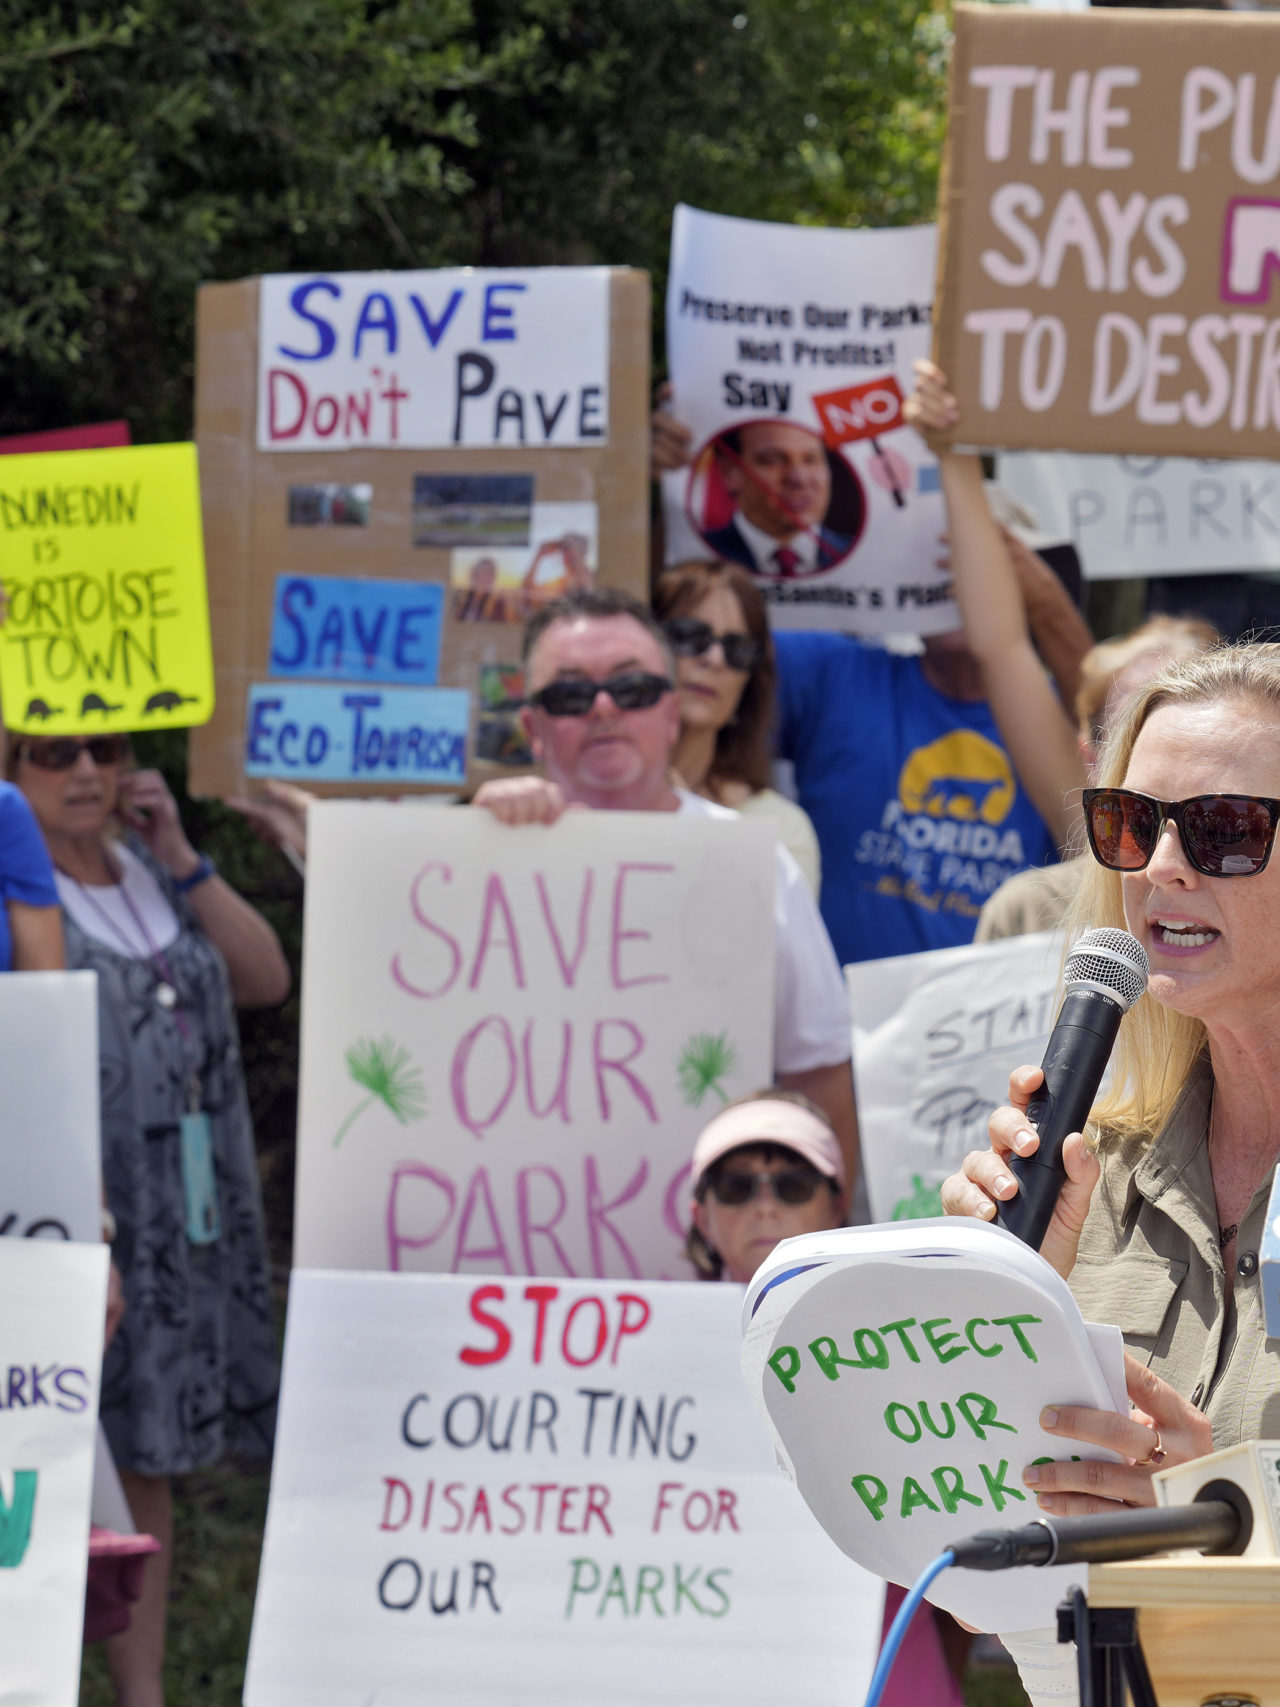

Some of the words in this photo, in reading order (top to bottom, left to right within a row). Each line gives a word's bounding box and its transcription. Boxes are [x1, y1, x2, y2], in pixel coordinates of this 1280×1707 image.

[970, 66, 1140, 168] THE
[980, 183, 1189, 298] SAYS
[278, 279, 529, 362] SAVE
[680, 288, 792, 326] Preserve
[804, 303, 848, 328] Our
[737, 336, 782, 363] Not
[793, 340, 895, 366] Profits!
[964, 309, 1066, 412] TO
[454, 352, 605, 444] PAVE
[723, 373, 792, 412] Say
[824, 388, 899, 435] NO
[0, 477, 141, 531] DUNEDIN
[33, 536, 61, 564] IS
[6, 626, 162, 687] TOWN
[271, 581, 432, 672] SAVE
[391, 861, 676, 1001] SAVE
[925, 993, 1052, 1058] STAT
[451, 1014, 659, 1141] OUR
[459, 1283, 651, 1368] STOP
[767, 1313, 1043, 1393] PROTECT
[0, 1363, 91, 1414] RKS
[883, 1391, 1019, 1443] OUR
[402, 1388, 697, 1462] COURTING
[378, 1477, 613, 1537] DISASTER
[651, 1482, 742, 1534] FOR
[851, 1456, 1081, 1522] PARK
[378, 1558, 502, 1617] OUR
[565, 1558, 733, 1621] PARKS
